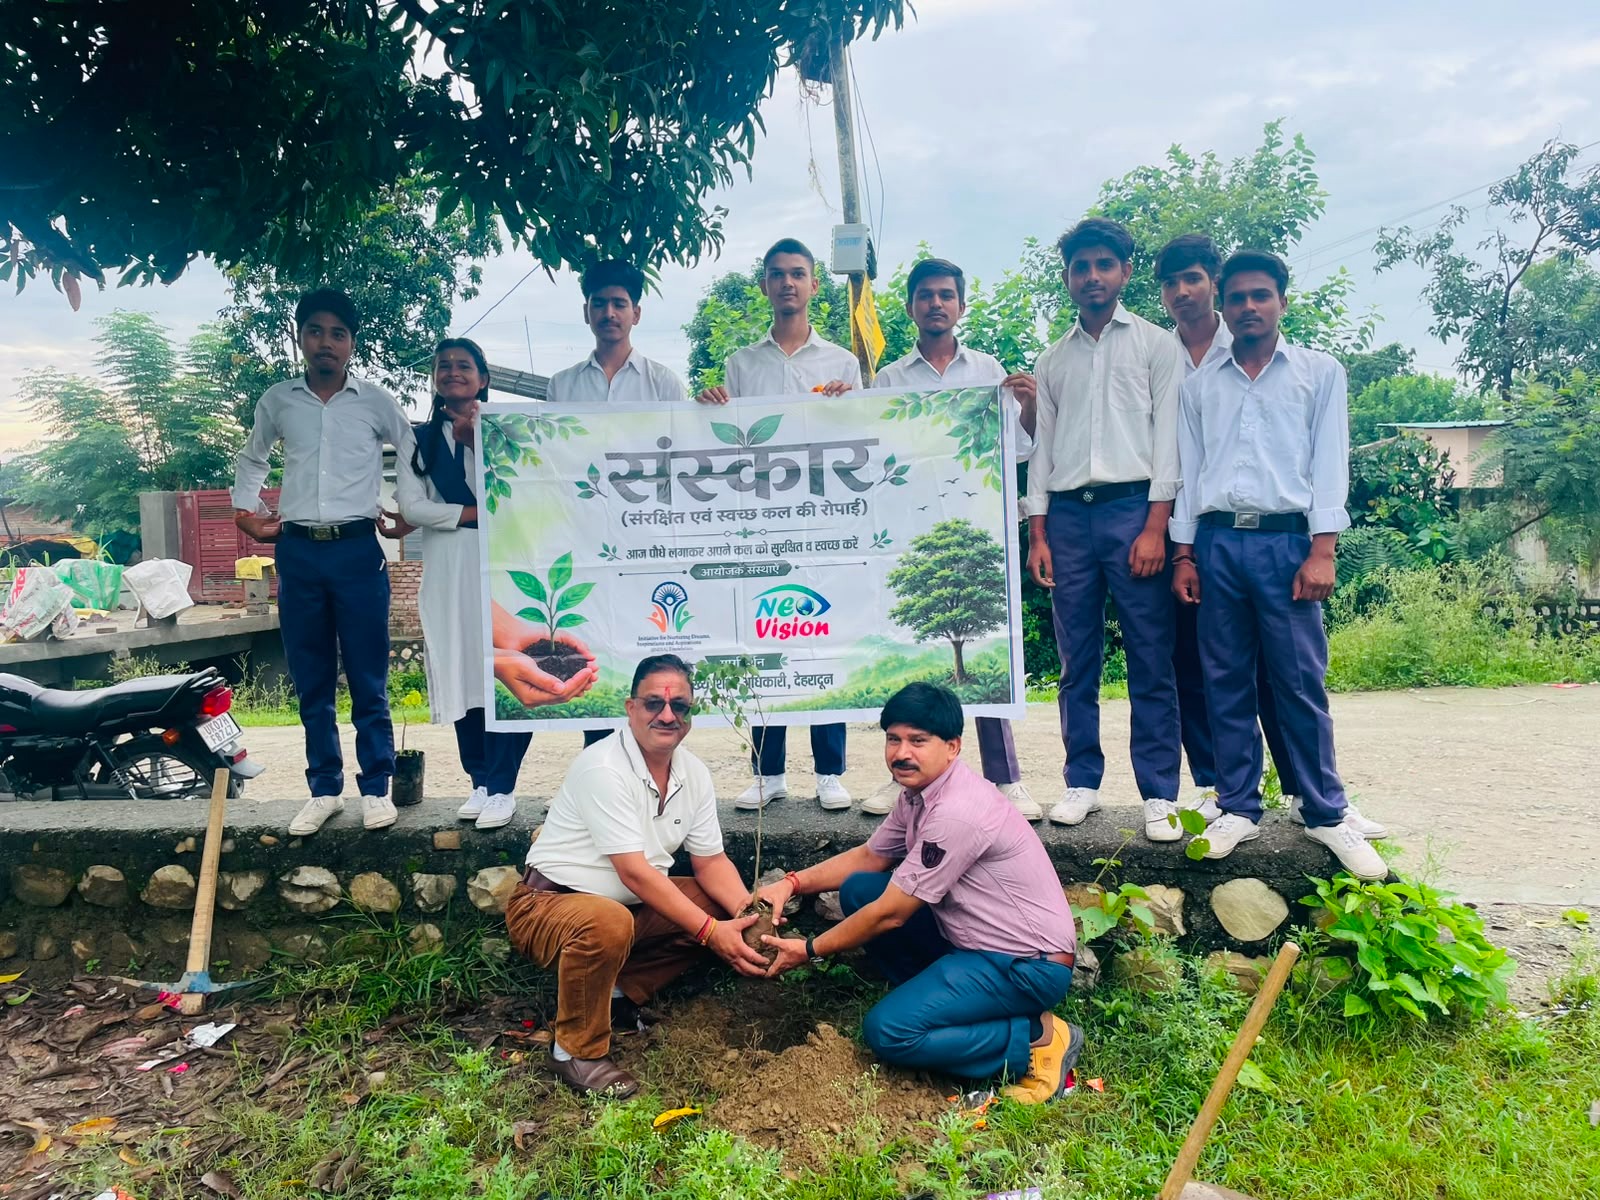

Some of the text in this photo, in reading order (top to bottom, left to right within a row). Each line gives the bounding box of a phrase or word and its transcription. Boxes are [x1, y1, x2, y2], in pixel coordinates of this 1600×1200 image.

[604, 436, 880, 506] संस्कार
[689, 507, 713, 524] एवं
[716, 507, 758, 522] स्वच्छ
[761, 505, 793, 519] कल
[796, 500, 817, 518] की
[820, 498, 868, 517] रोपाई)
[626, 535, 860, 560] आज पौधे लगाकर अपने कल को सुरक्षित व स्वच्छ करें
[700, 564, 744, 577] आयोजक
[755, 616, 829, 640] Vision
[793, 671, 834, 690] देहरादून
